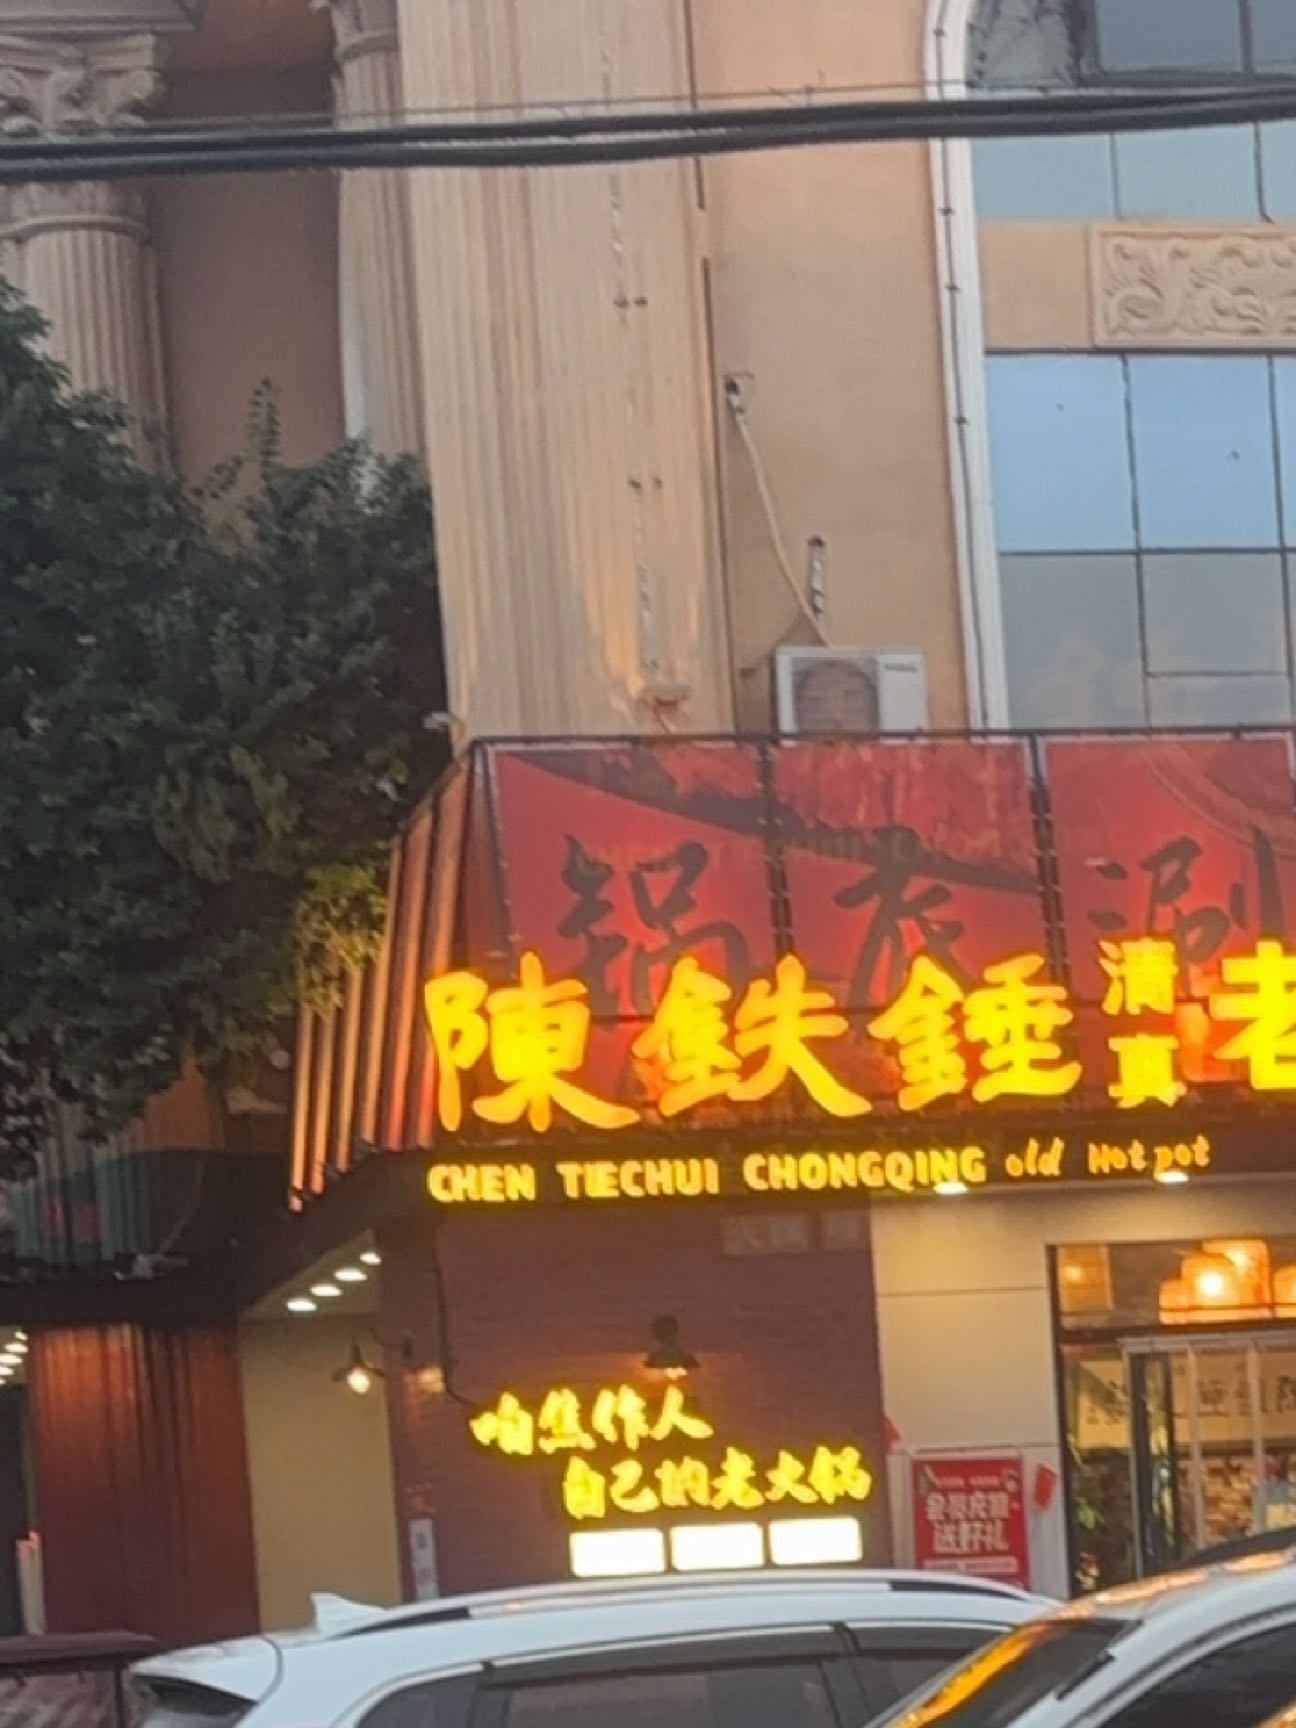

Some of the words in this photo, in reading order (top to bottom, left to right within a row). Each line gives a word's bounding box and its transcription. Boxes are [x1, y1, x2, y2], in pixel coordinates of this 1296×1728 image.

[1100, 938, 1186, 1108] 清真
[428, 1163, 536, 1202] CHEN
[743, 1146, 986, 1192] CHONGQING
[1005, 1137, 1064, 1176] old
[1088, 1139, 1146, 1174] Hot
[1154, 1134, 1210, 1172] pot
[562, 1446, 871, 1519] 自己的老火锅
